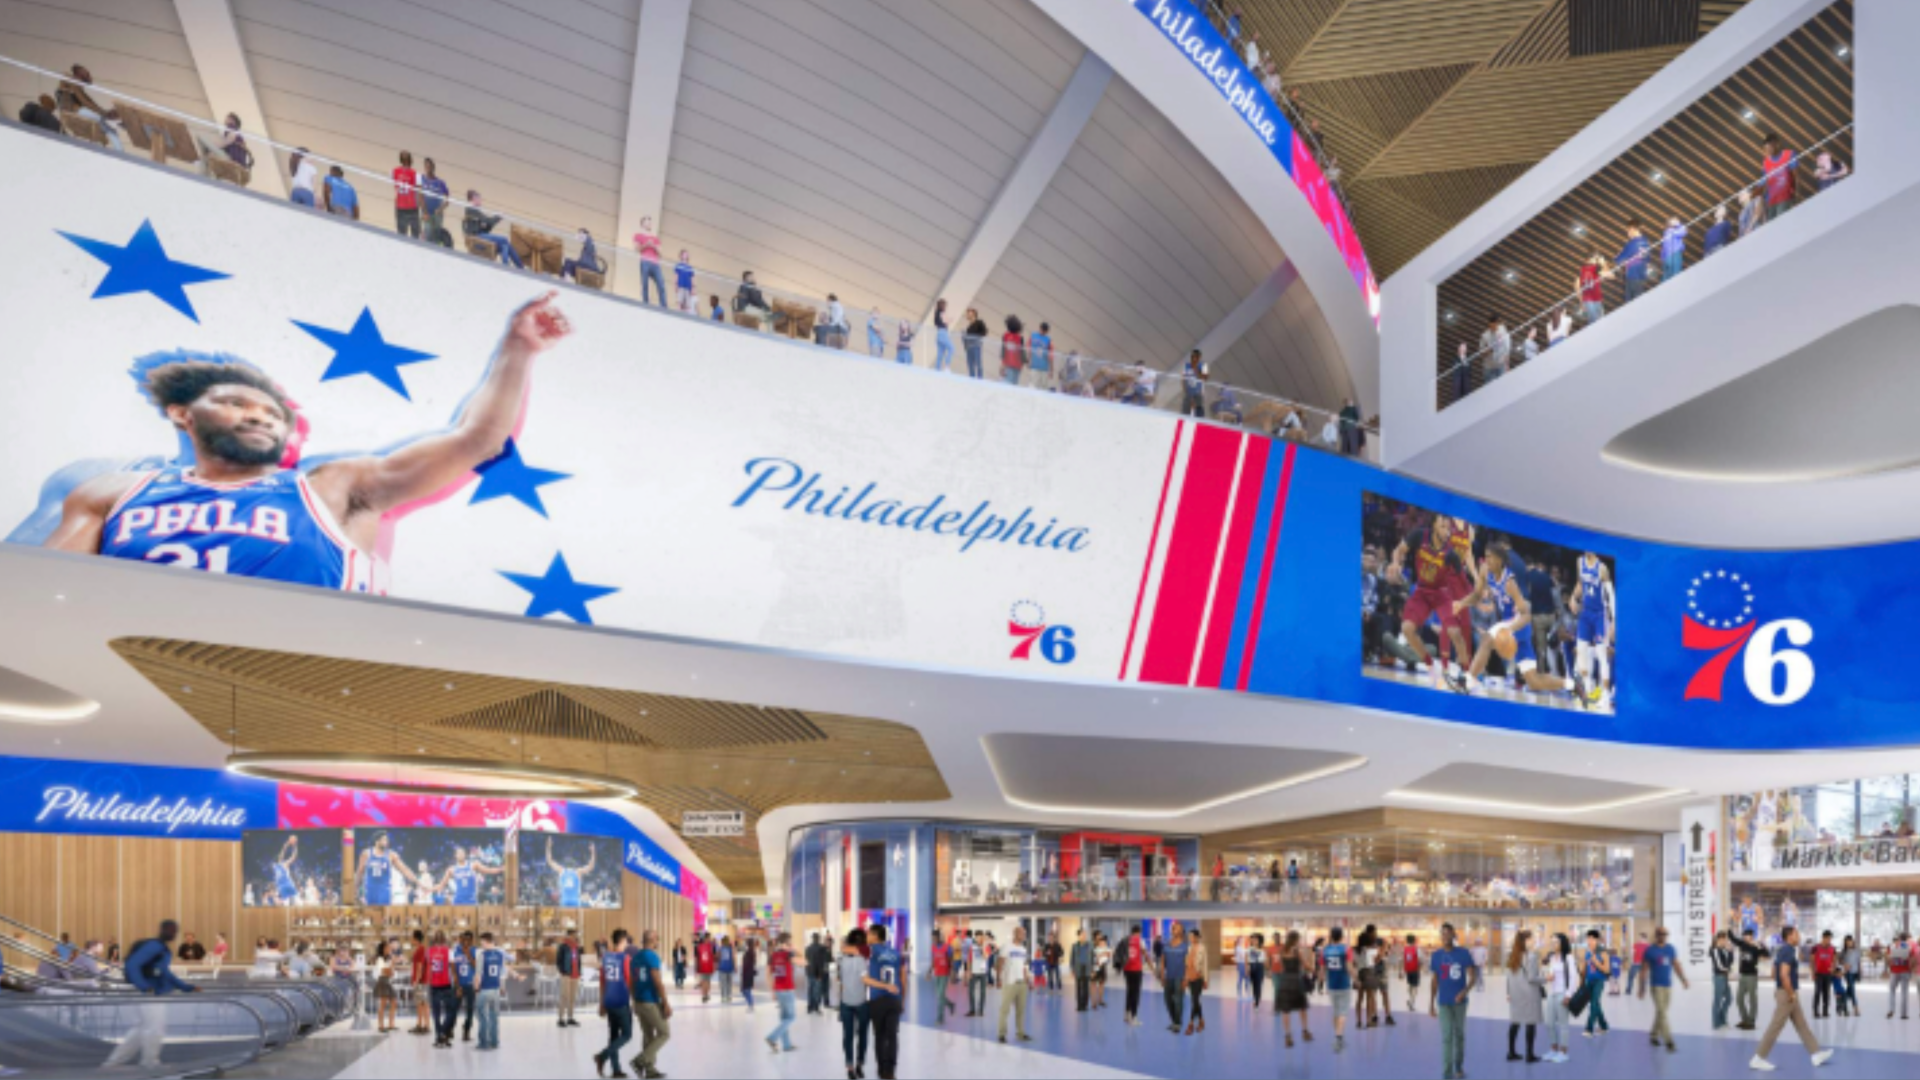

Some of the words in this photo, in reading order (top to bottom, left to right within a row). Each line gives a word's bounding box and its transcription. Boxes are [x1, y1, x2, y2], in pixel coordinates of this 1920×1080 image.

[1130, 0, 1276, 145] hiladelphia
[113, 498, 291, 545] PHILA
[730, 456, 1091, 553] Philadelphia
[1008, 619, 1077, 665] 76
[1682, 613, 1816, 706] 76
[35, 785, 247, 834] Philadelphia
[1781, 842, 1862, 869] Market
[1690, 857, 1705, 920] STREET
[1690, 926, 1705, 966] 10TH
